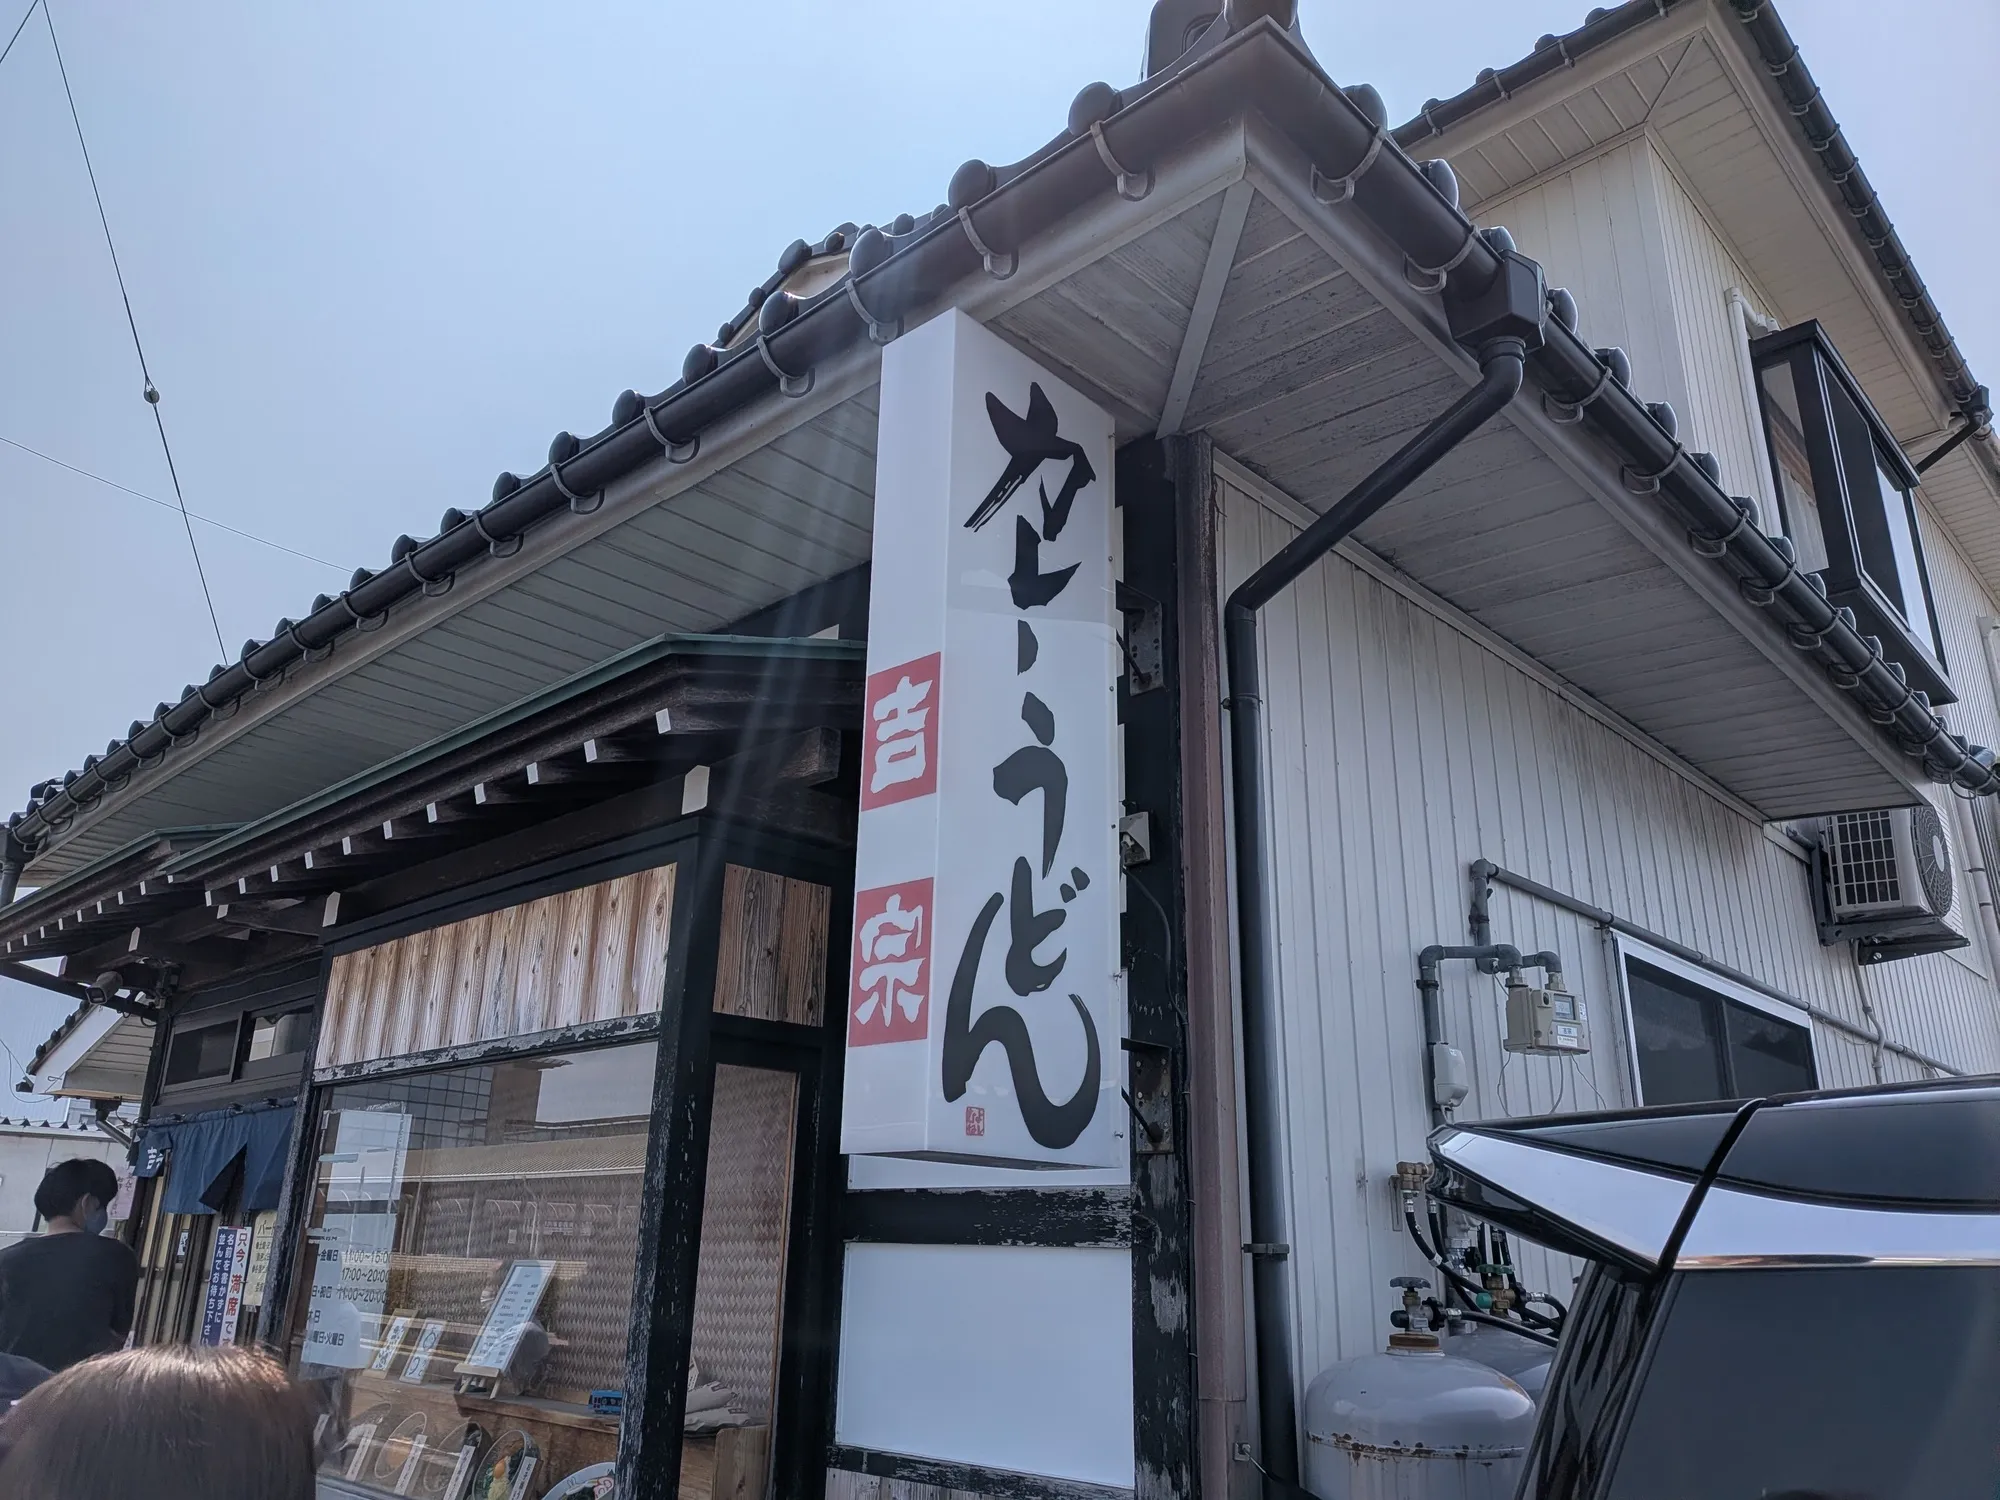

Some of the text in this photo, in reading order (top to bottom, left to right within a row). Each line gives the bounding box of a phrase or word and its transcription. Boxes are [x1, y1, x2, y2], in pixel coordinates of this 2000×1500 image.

[854, 675, 933, 1028] 吉宗
[942, 381, 1101, 1149] カレーうどん
[201, 1233, 227, 1345] 並んでお待ち下さい
[214, 1233, 236, 1323] 名前を書かずに
